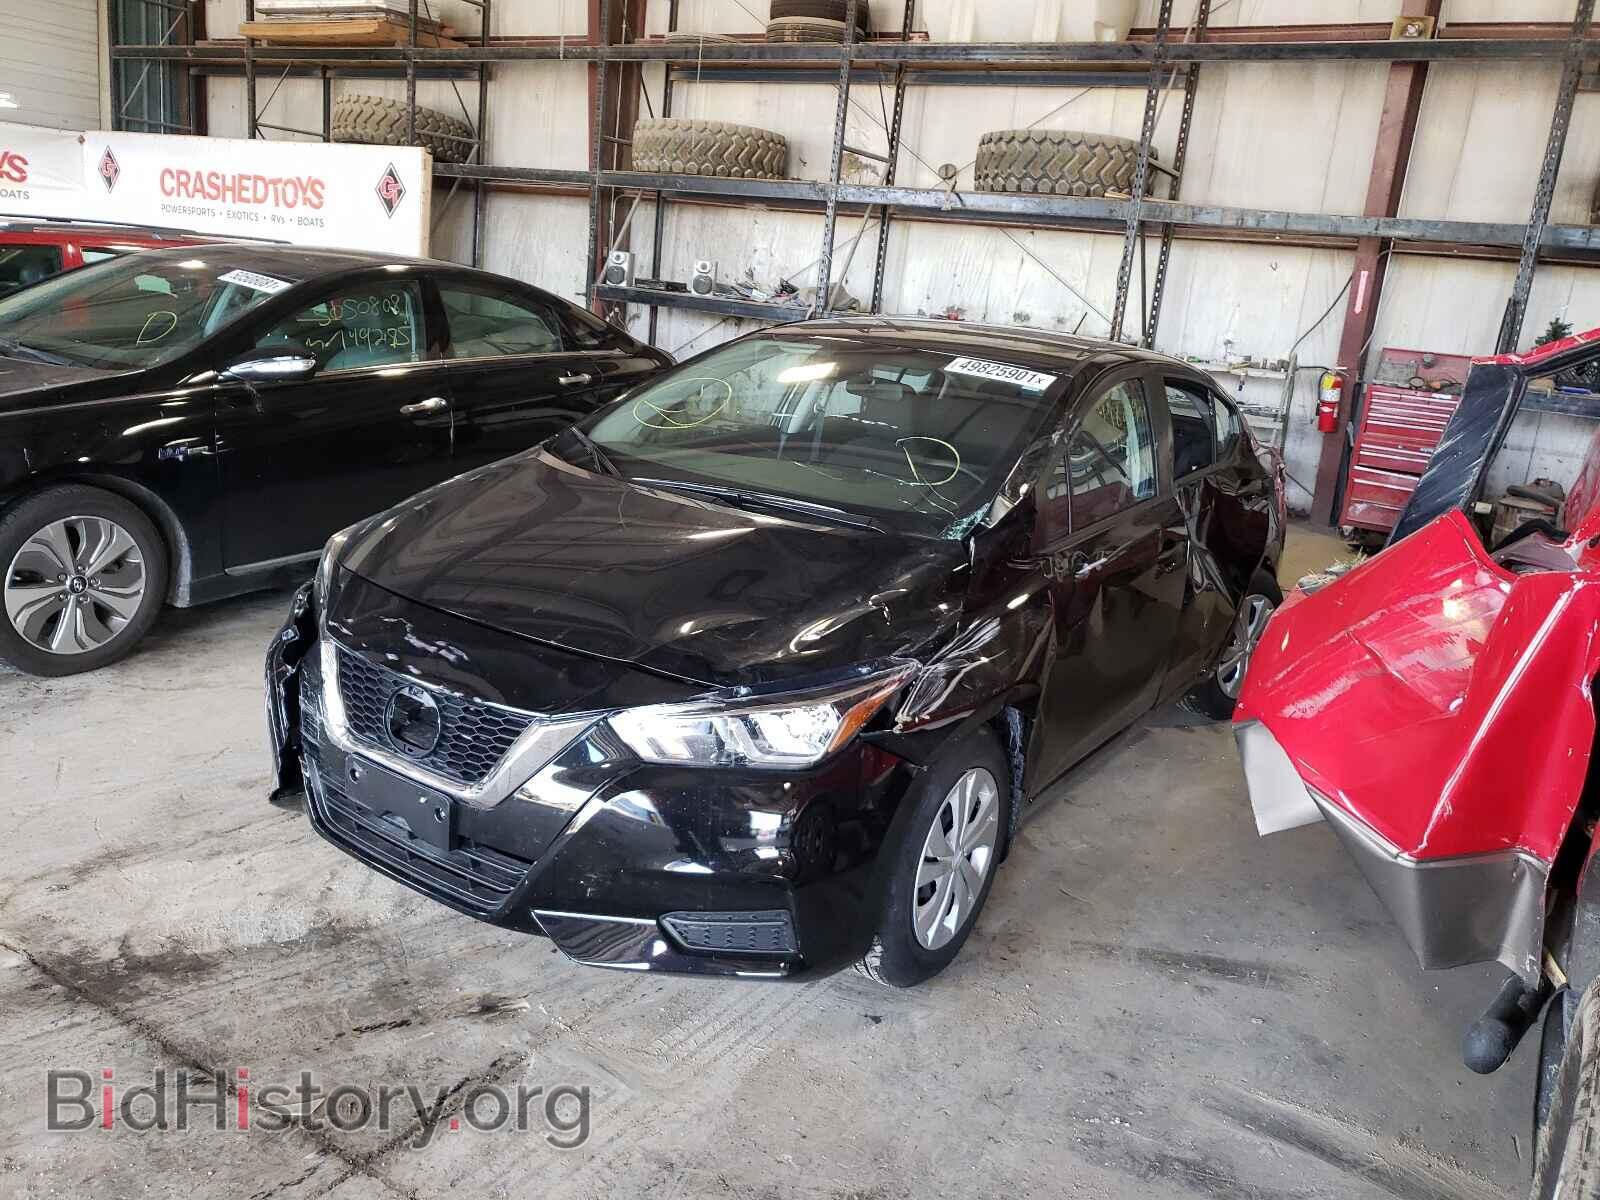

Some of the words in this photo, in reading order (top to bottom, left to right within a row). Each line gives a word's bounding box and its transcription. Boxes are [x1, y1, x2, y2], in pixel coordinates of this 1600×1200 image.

[160, 167, 326, 210] CRASHEDTOYS
[161, 203, 216, 218] POWERSPORTS
[226, 209, 259, 222] EXOTICS
[297, 216, 325, 228] BOATS
